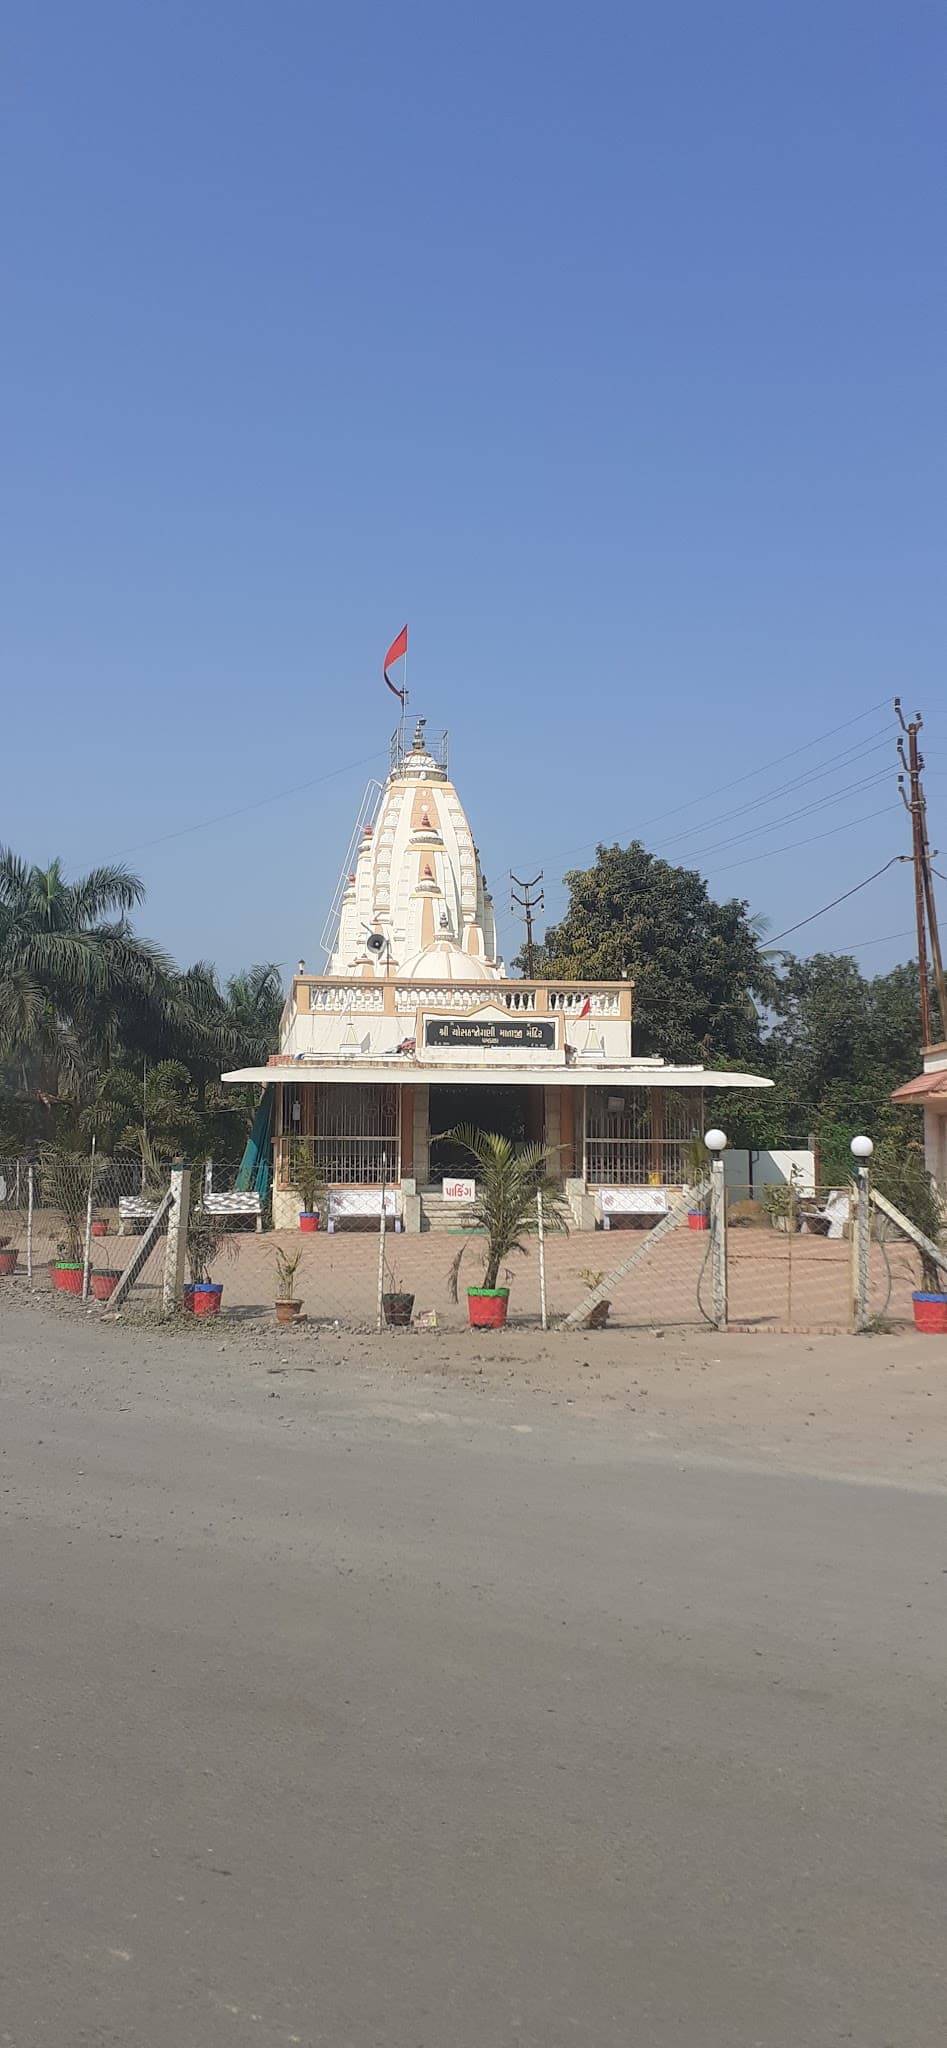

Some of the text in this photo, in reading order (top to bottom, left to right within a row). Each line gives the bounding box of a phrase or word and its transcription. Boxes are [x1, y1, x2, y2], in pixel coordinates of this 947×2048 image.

[439, 1025, 449, 1037] શ્રી
[499, 1029, 523, 1039] માતાજી
[526, 1026, 543, 1039] મંદિર
[445, 1183, 472, 1197] પાર્કિંગ
